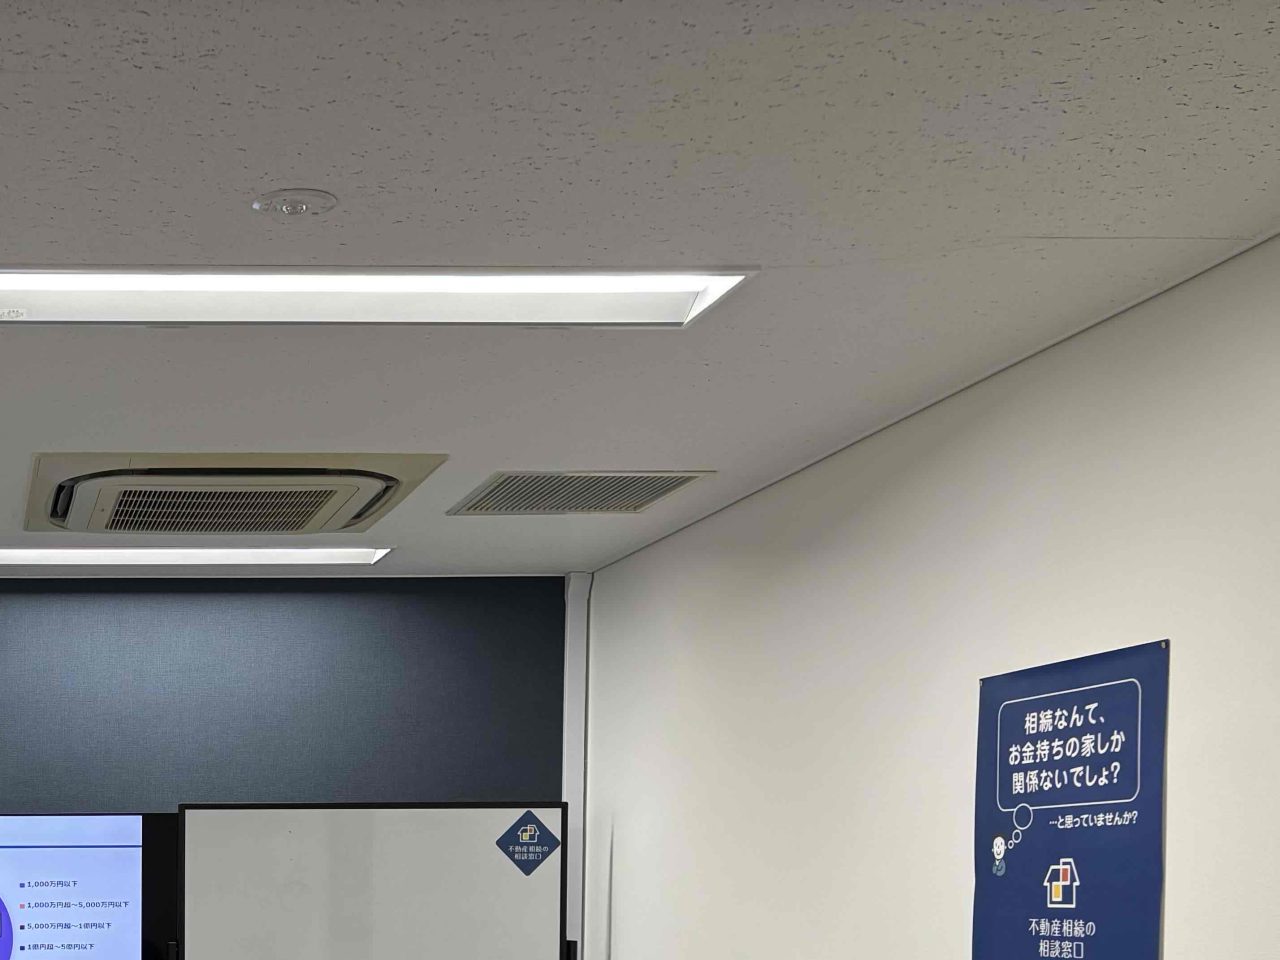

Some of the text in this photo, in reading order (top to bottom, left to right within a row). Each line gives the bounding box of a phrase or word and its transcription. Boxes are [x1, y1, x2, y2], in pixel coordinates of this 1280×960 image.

[1024, 702, 1105, 735] 相続なんて、
[1008, 730, 1126, 765] お金持ちの家しか
[1012, 761, 1121, 794] 関係ないでしょ？
[27, 880, 78, 888] 1,000万円以下
[1028, 918, 1096, 937] 不動産相続の
[1039, 940, 1084, 959] 相談窓口
